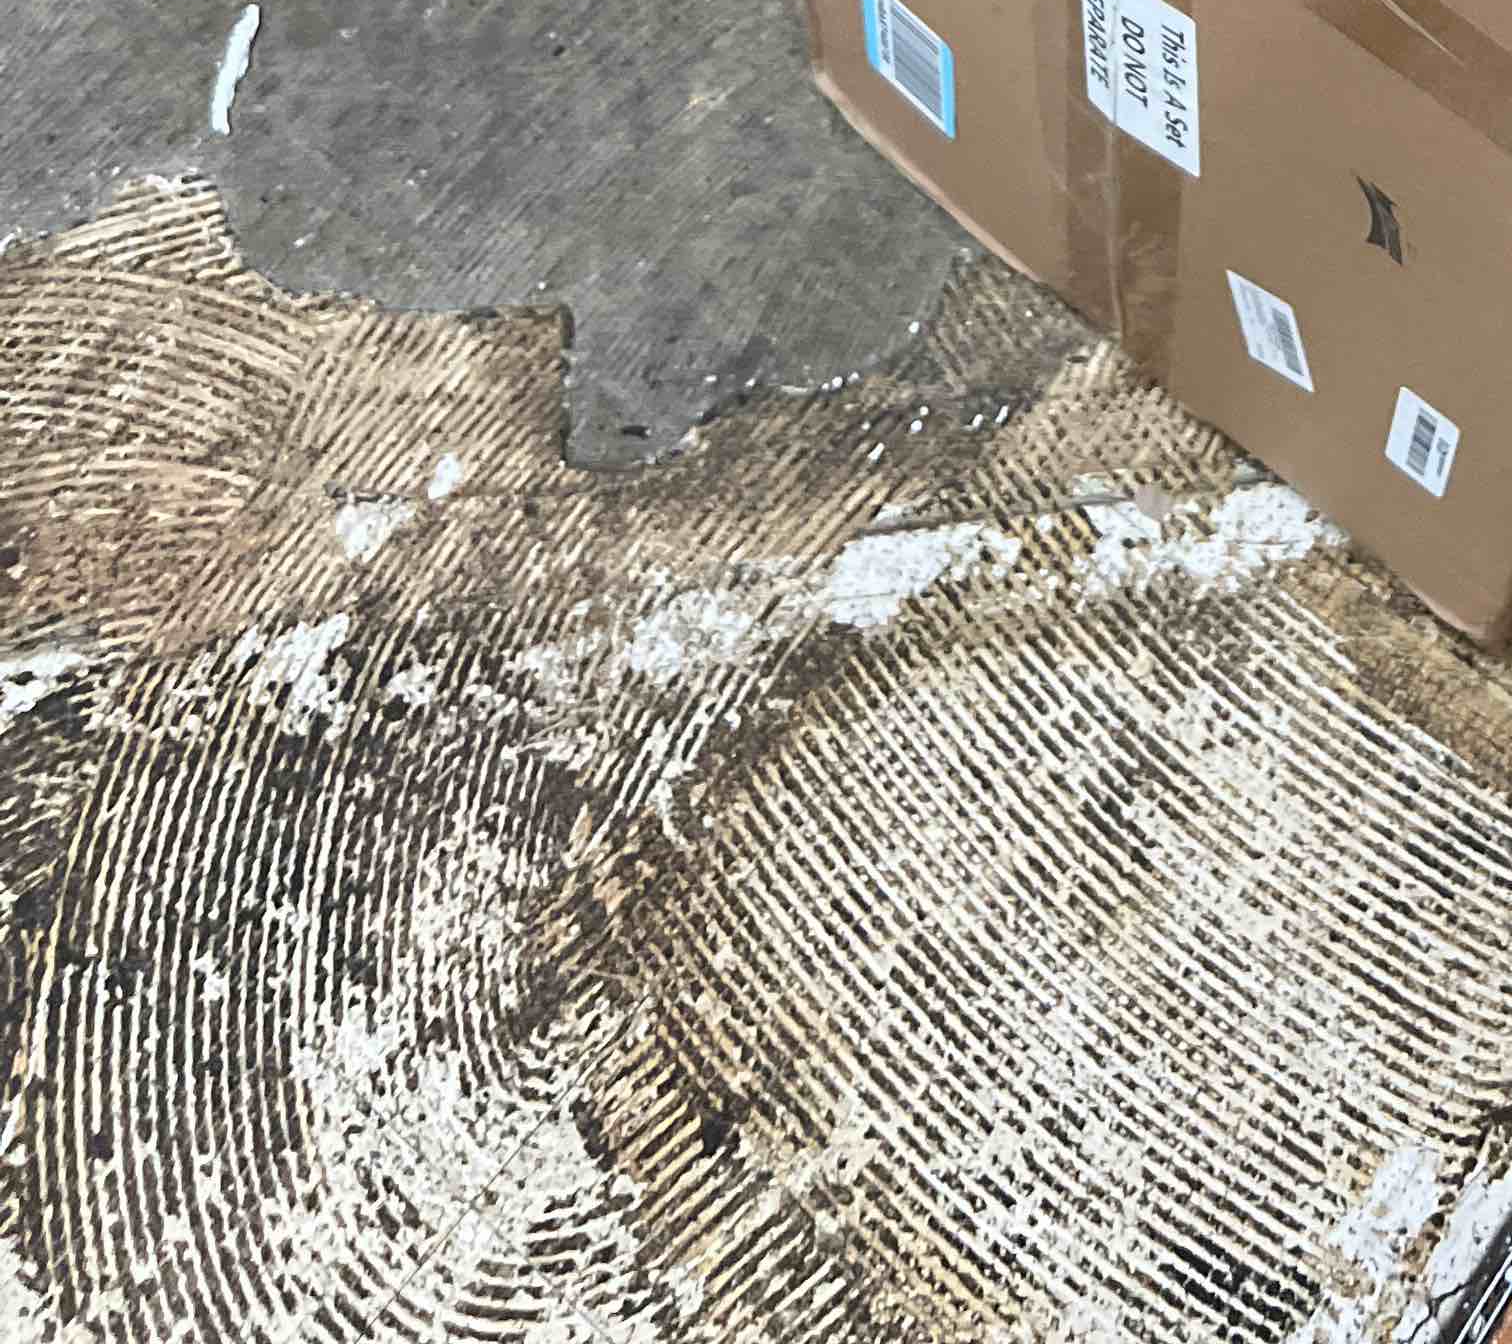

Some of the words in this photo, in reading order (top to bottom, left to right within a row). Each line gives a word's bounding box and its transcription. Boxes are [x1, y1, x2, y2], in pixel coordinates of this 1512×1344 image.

[1121, 15, 1146, 55] DO
[1160, 23, 1187, 69] This
[1123, 53, 1149, 109] NOT
[1162, 68, 1186, 90] Is
[1165, 89, 1188, 111] A
[1165, 111, 1189, 148] Set
